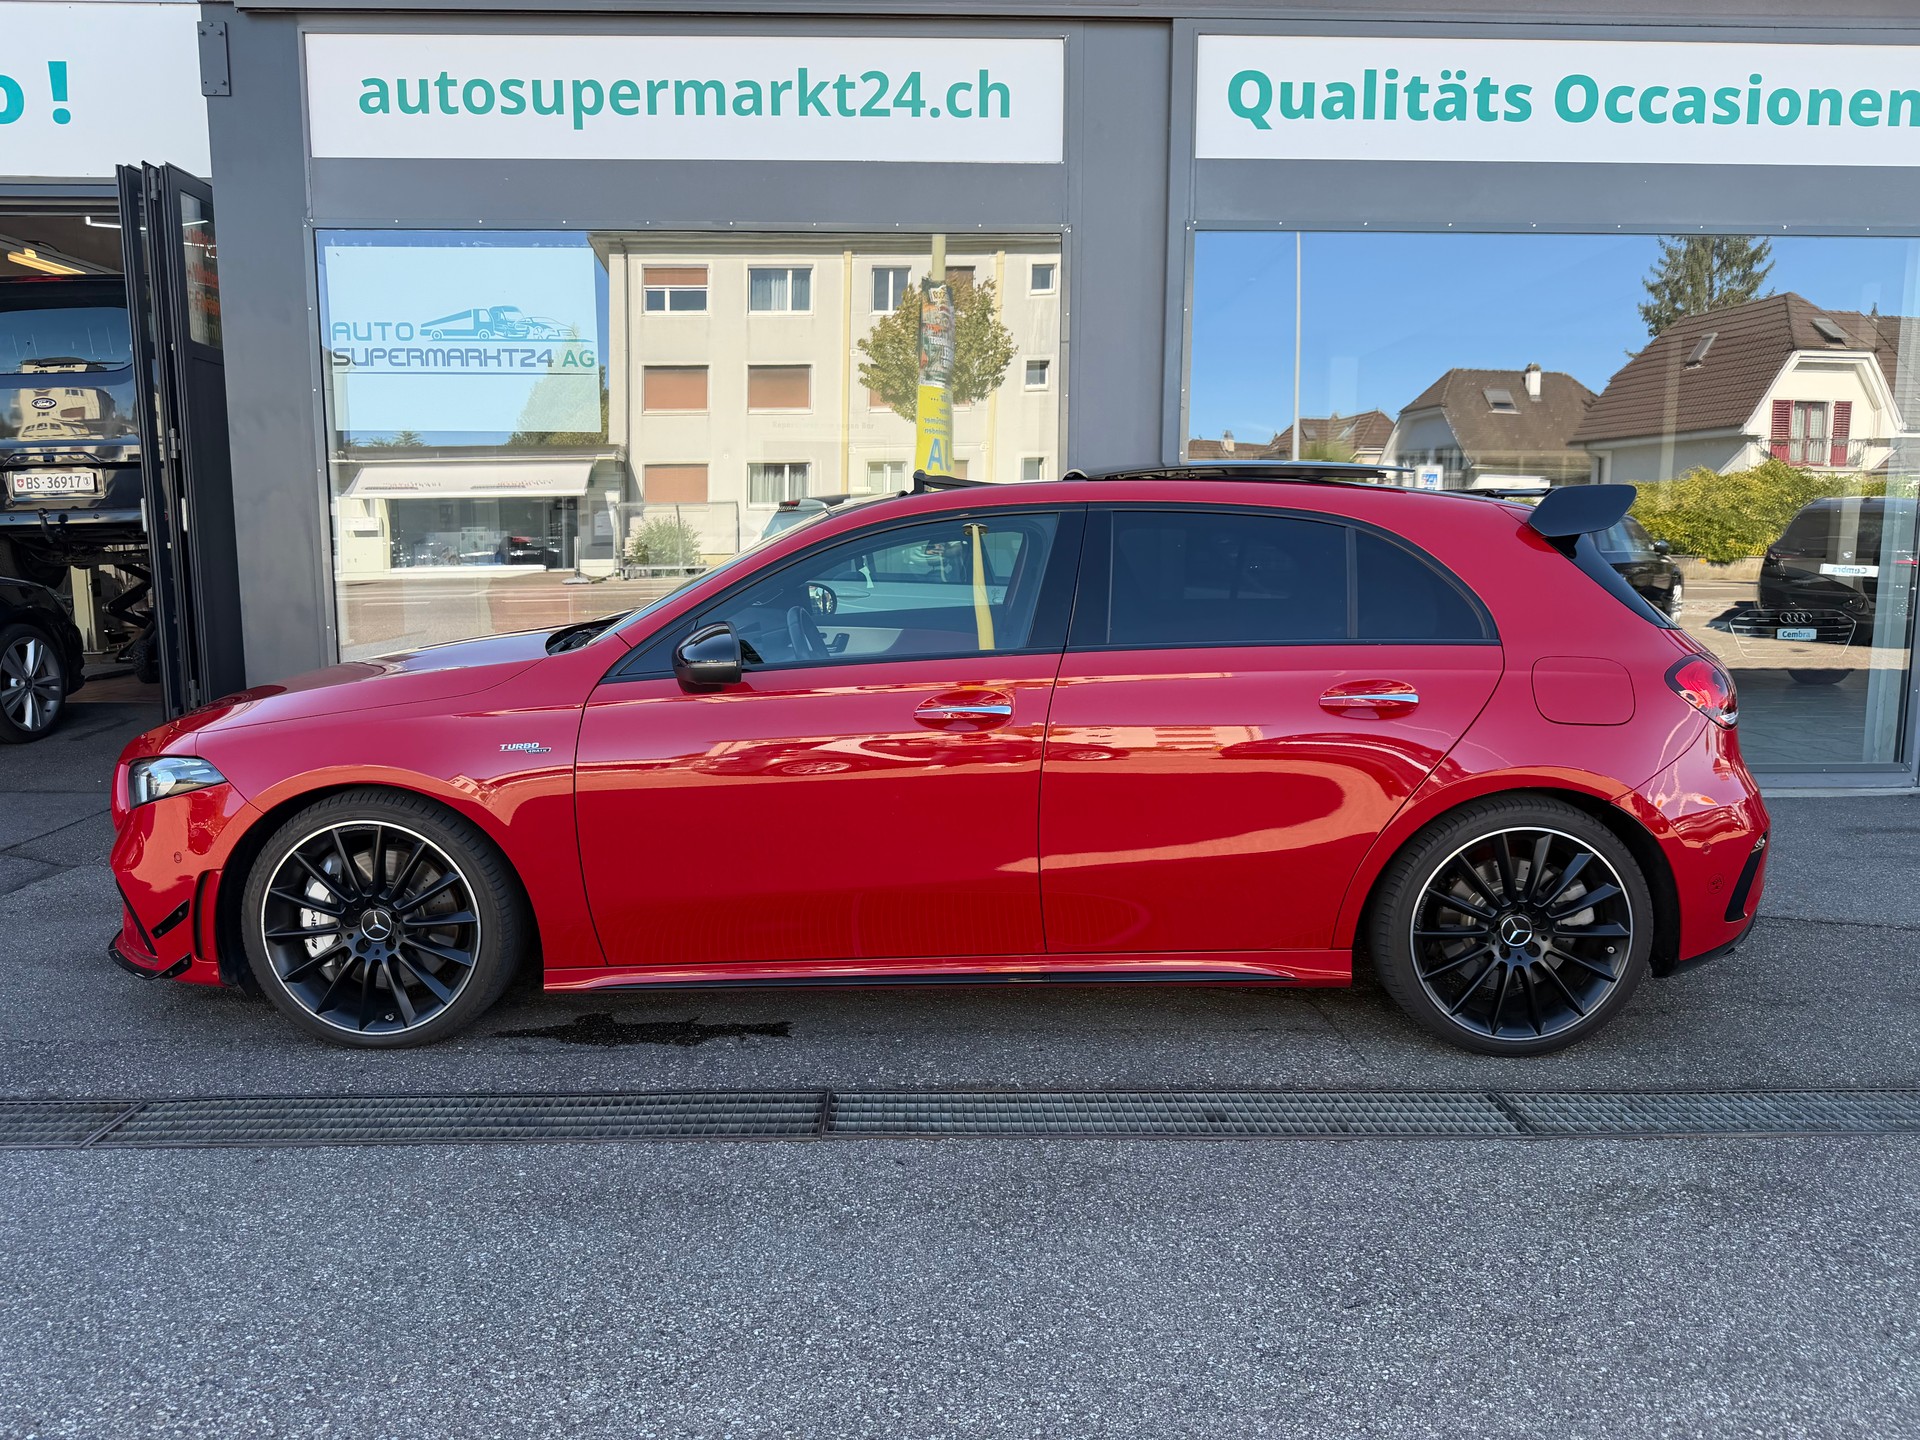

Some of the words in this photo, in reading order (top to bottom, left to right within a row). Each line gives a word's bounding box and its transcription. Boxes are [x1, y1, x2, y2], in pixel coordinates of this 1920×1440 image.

[358, 67, 1011, 131] autosupermarkt24.ch
[1227, 68, 1533, 131] Qualitäts
[1554, 72, 1920, 128] Occasionen
[332, 322, 414, 341] AUTO
[332, 347, 554, 368] SUPERMARKT24
[562, 349, 595, 368] AG
[1782, 629, 1811, 638] Cembra
[500, 742, 540, 751] TURBO
